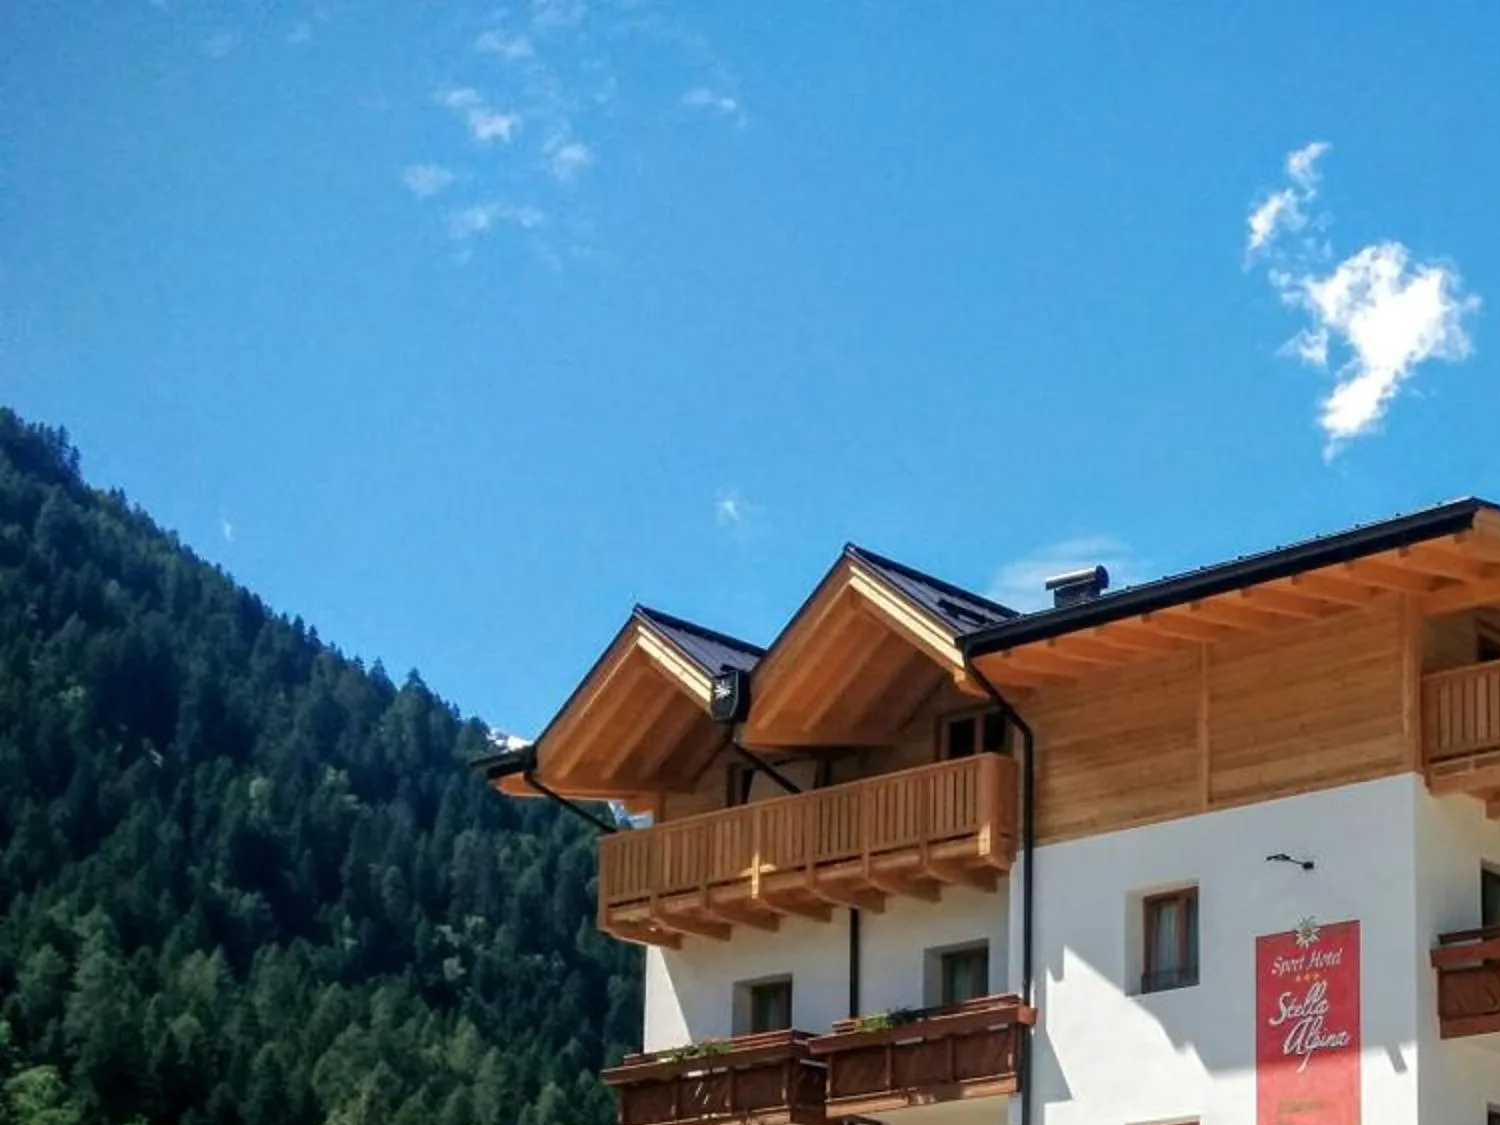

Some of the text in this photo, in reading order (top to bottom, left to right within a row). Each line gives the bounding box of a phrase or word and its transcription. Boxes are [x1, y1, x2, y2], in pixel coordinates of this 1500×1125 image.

[1272, 948, 1343, 977] Sport Hotel
[1268, 980, 1329, 1026] Stella
[1283, 1016, 1350, 1073] Alpina
